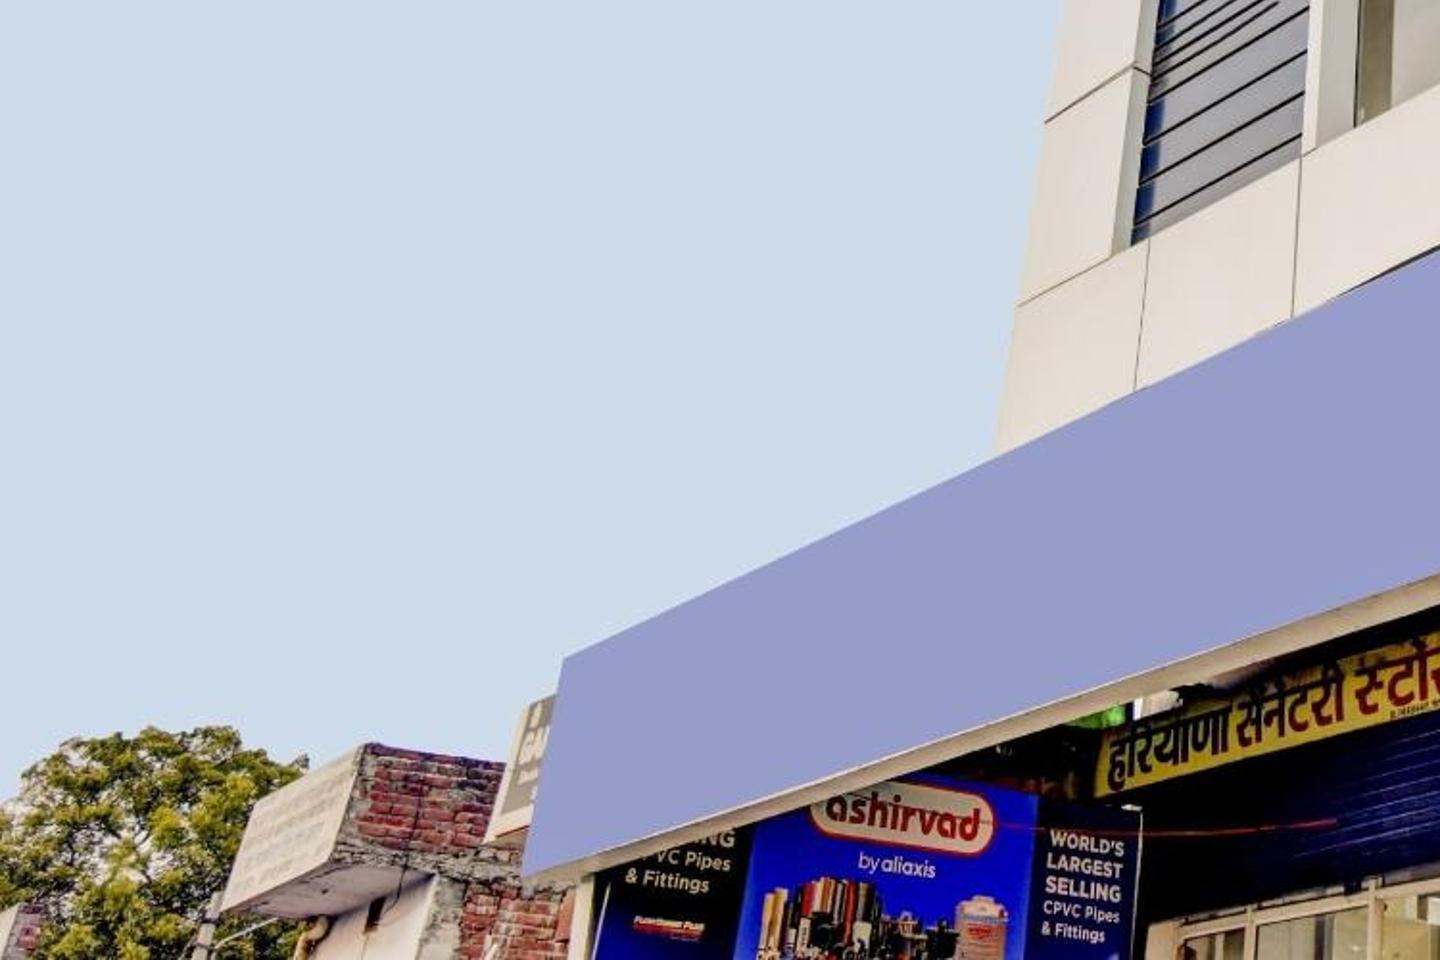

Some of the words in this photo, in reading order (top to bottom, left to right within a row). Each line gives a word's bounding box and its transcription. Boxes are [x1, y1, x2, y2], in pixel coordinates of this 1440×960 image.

[1108, 705, 1232, 791] हरियाणा
[825, 791, 981, 841] ashirvad
[1050, 828, 1124, 857] WORLD'S
[685, 851, 731, 871] Pipes
[858, 851, 880, 874] by
[881, 854, 936, 879] aliaxis
[1046, 852, 1123, 878] LARGEST
[625, 867, 638, 884] &
[643, 870, 709, 894] Fittings
[1045, 875, 1121, 903] SELLING
[1043, 900, 1081, 918] CPVC
[1084, 905, 1119, 924] Pipes
[1041, 921, 1051, 935] &
[1055, 923, 1105, 944] Fittings
